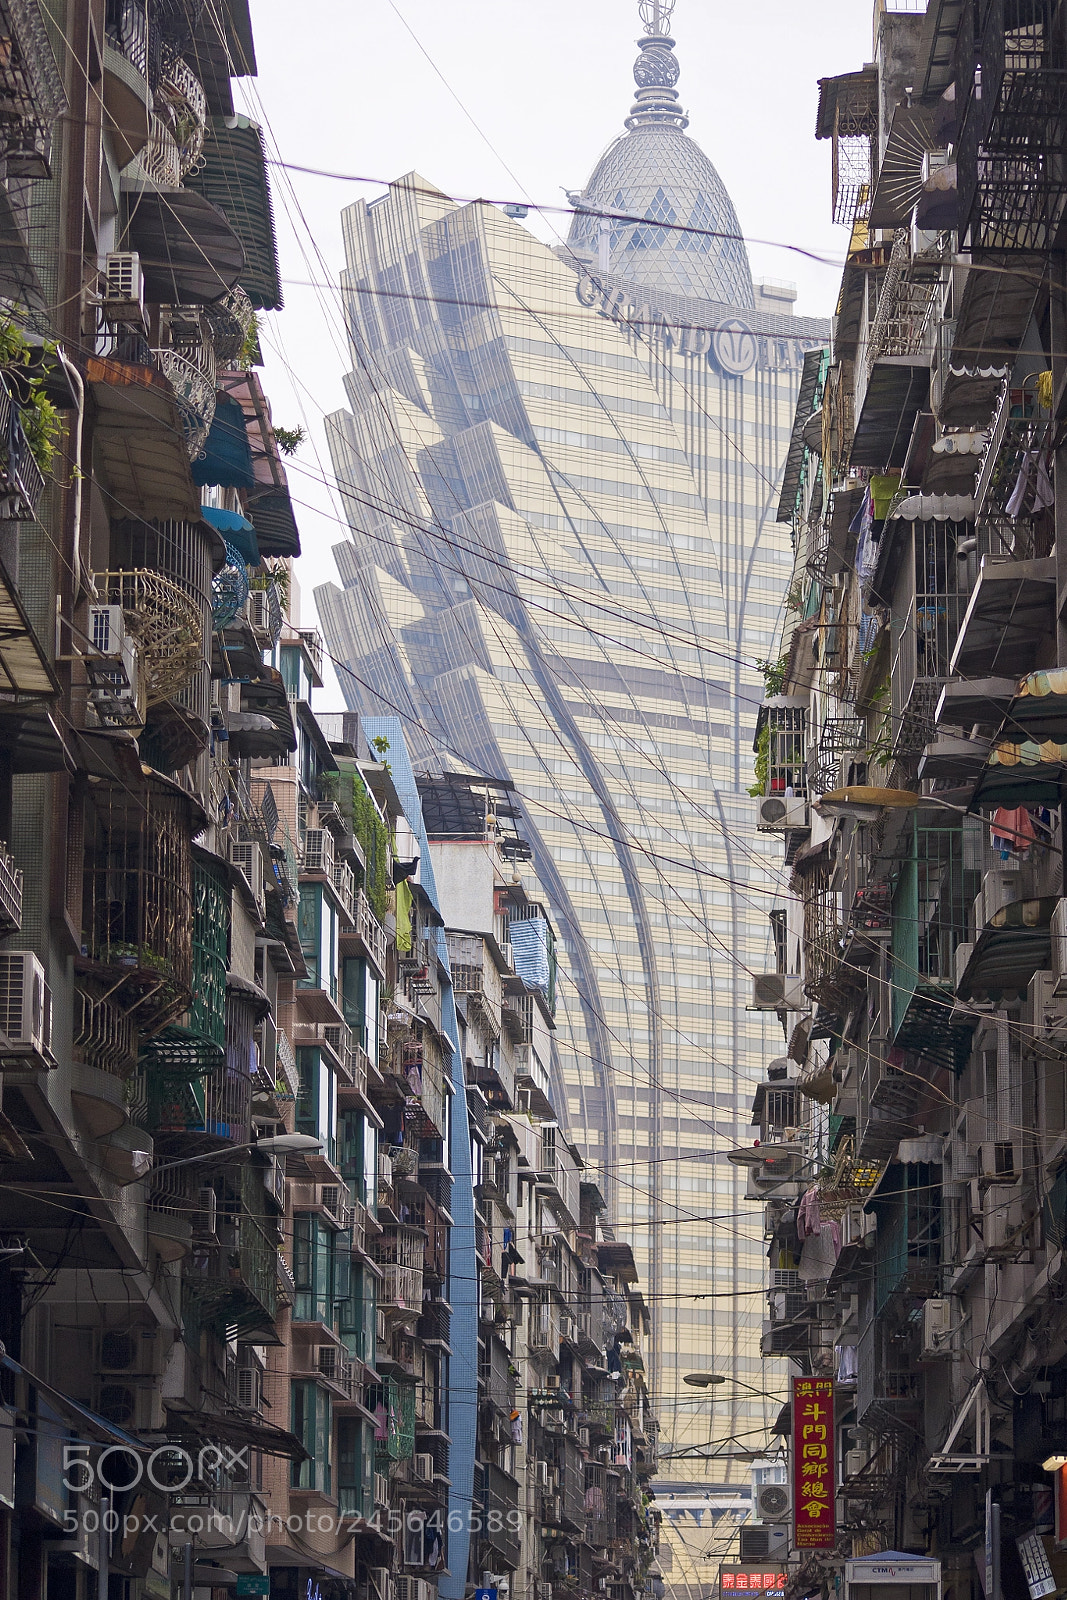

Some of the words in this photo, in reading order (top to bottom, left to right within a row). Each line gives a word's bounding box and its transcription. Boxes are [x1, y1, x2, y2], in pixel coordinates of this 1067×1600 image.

[577, 275, 711, 355] GRAND
[796, 1382, 832, 1398] 澳門
[801, 1402, 830, 1518] 斗門同鄉總會
